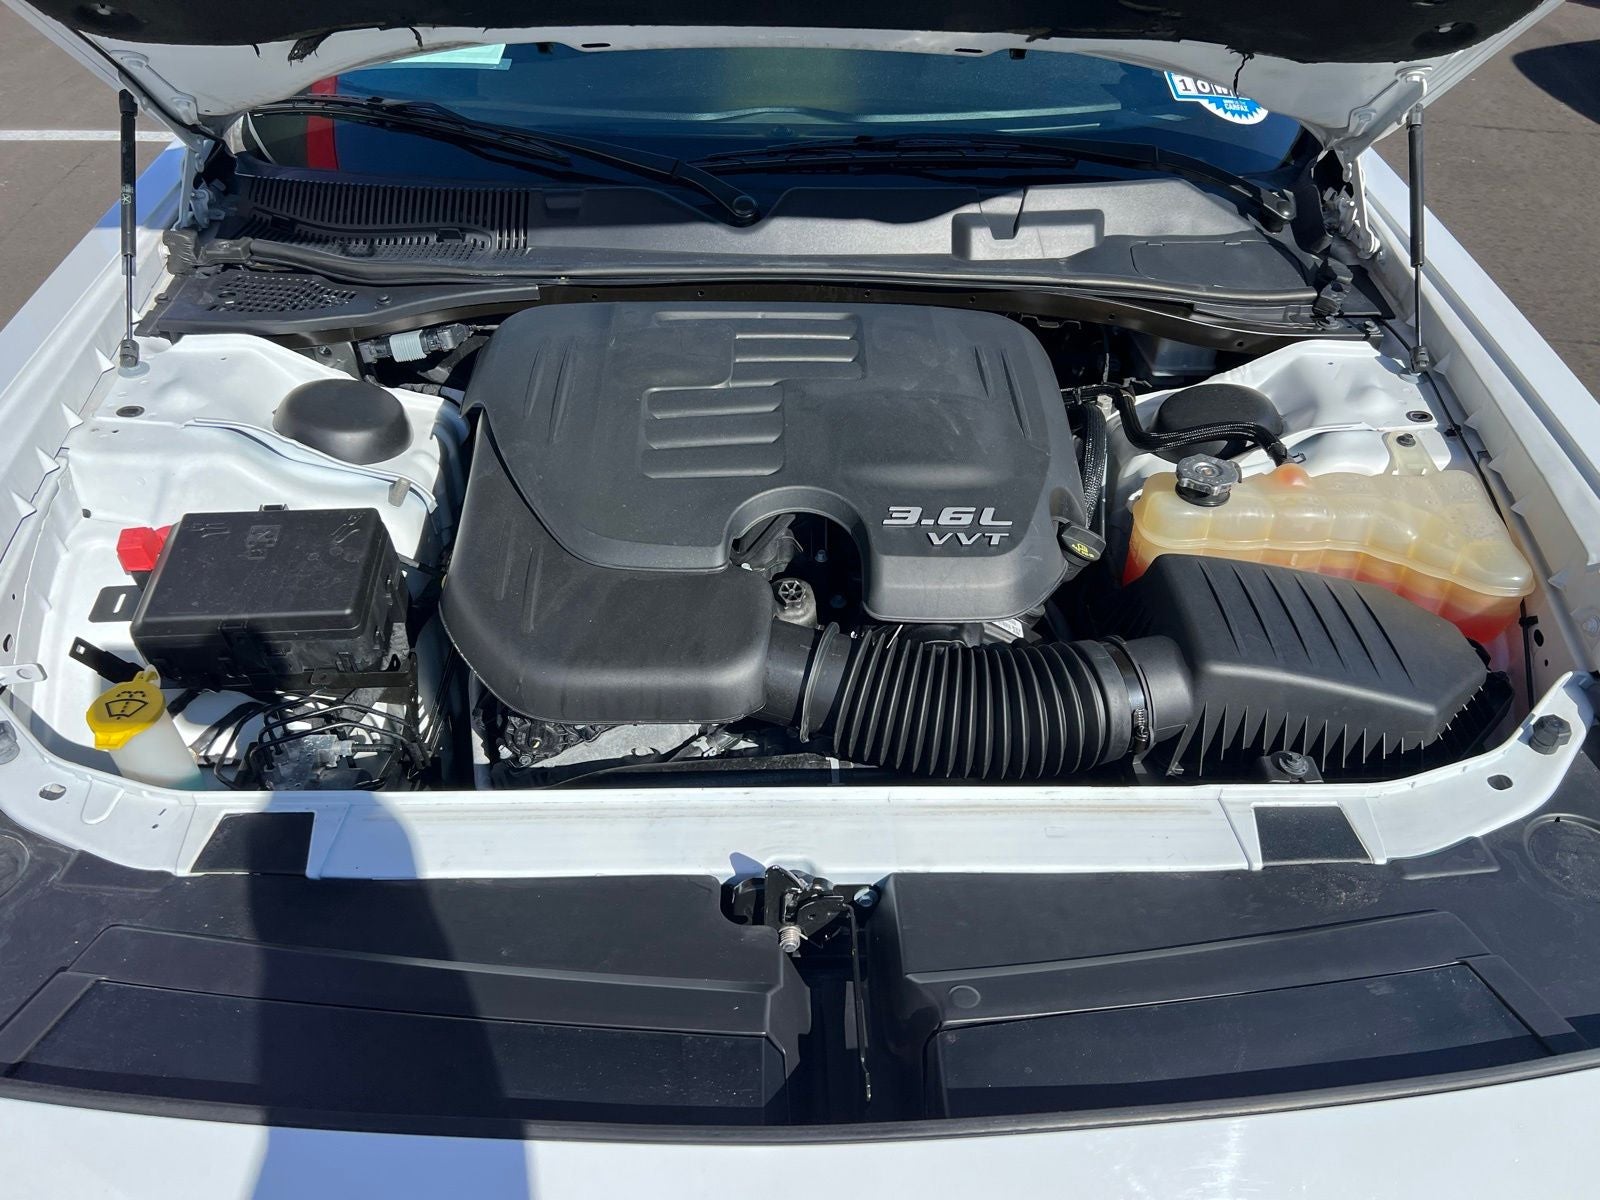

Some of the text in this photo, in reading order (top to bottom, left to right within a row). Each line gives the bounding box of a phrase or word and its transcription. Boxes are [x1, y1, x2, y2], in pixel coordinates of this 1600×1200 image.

[1179, 79, 1191, 92] 1
[882, 506, 1013, 526] 3.6L
[926, 532, 1010, 546] VVT
